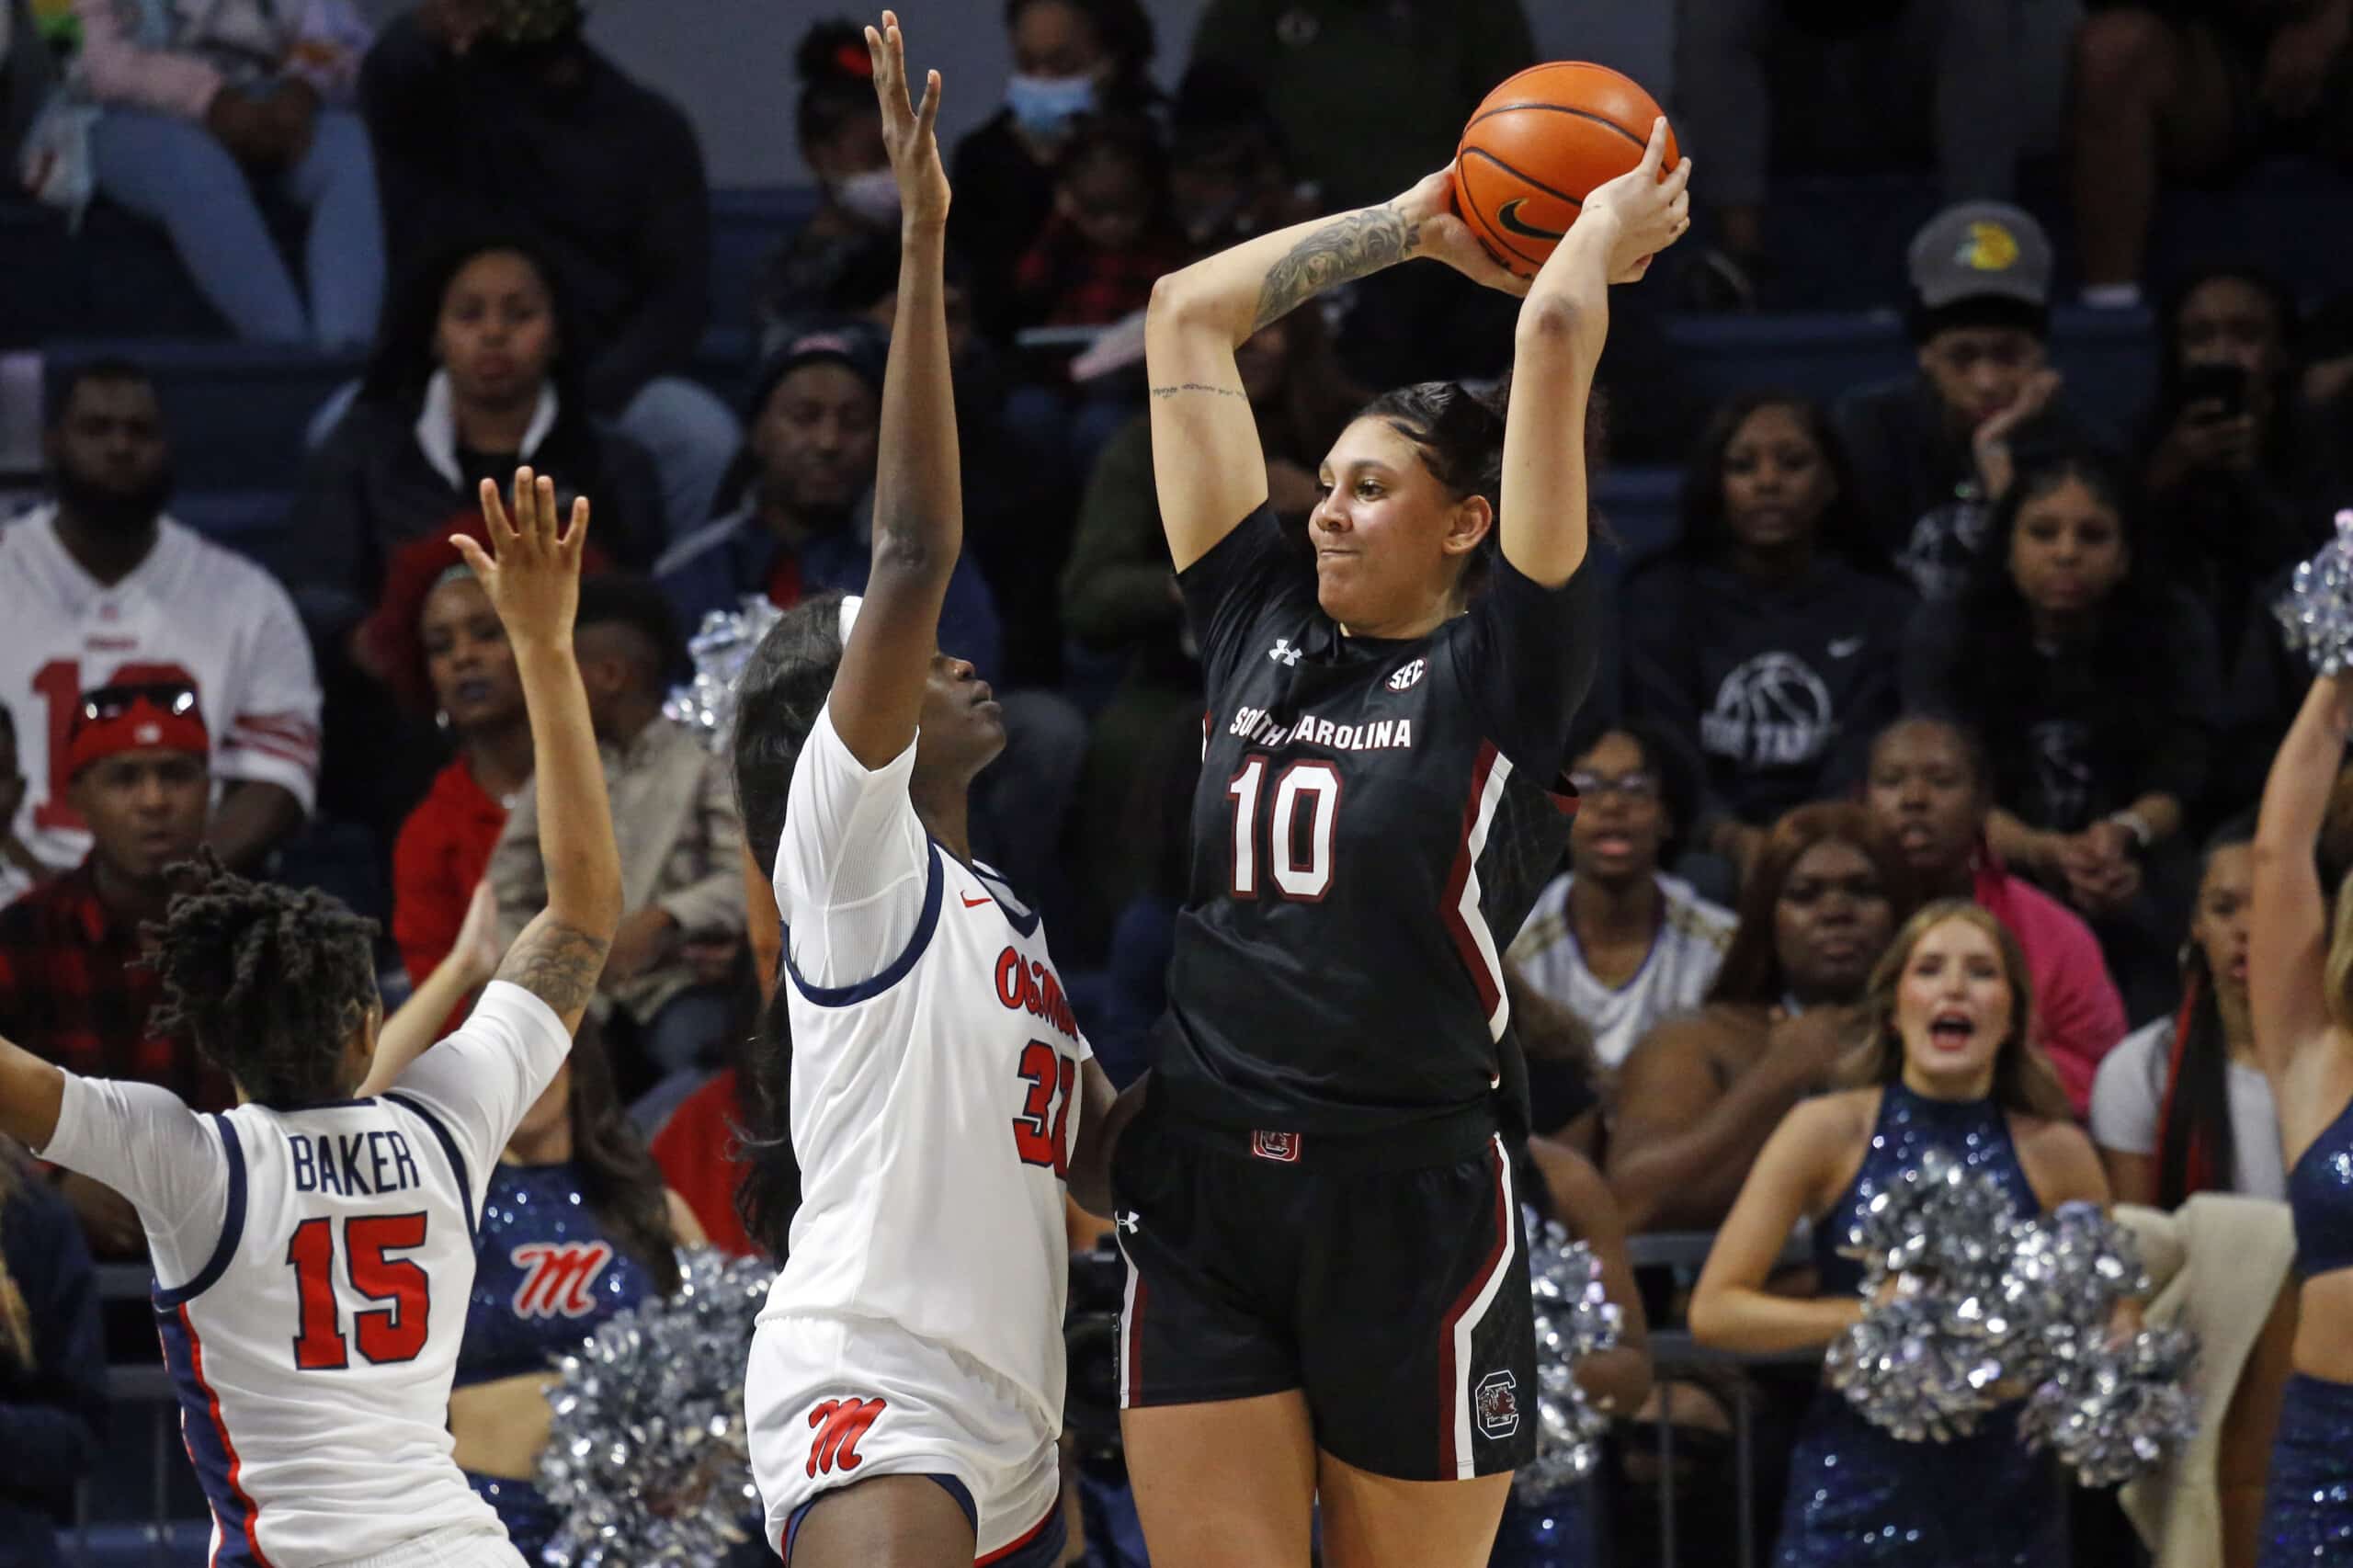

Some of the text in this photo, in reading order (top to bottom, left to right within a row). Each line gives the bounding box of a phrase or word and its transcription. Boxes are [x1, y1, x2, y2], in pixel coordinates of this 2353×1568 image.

[1389, 659, 1425, 689] SEC
[1228, 758, 1340, 899] 10
[289, 1131, 420, 1197] BAKER
[286, 1210, 430, 1370] 15
